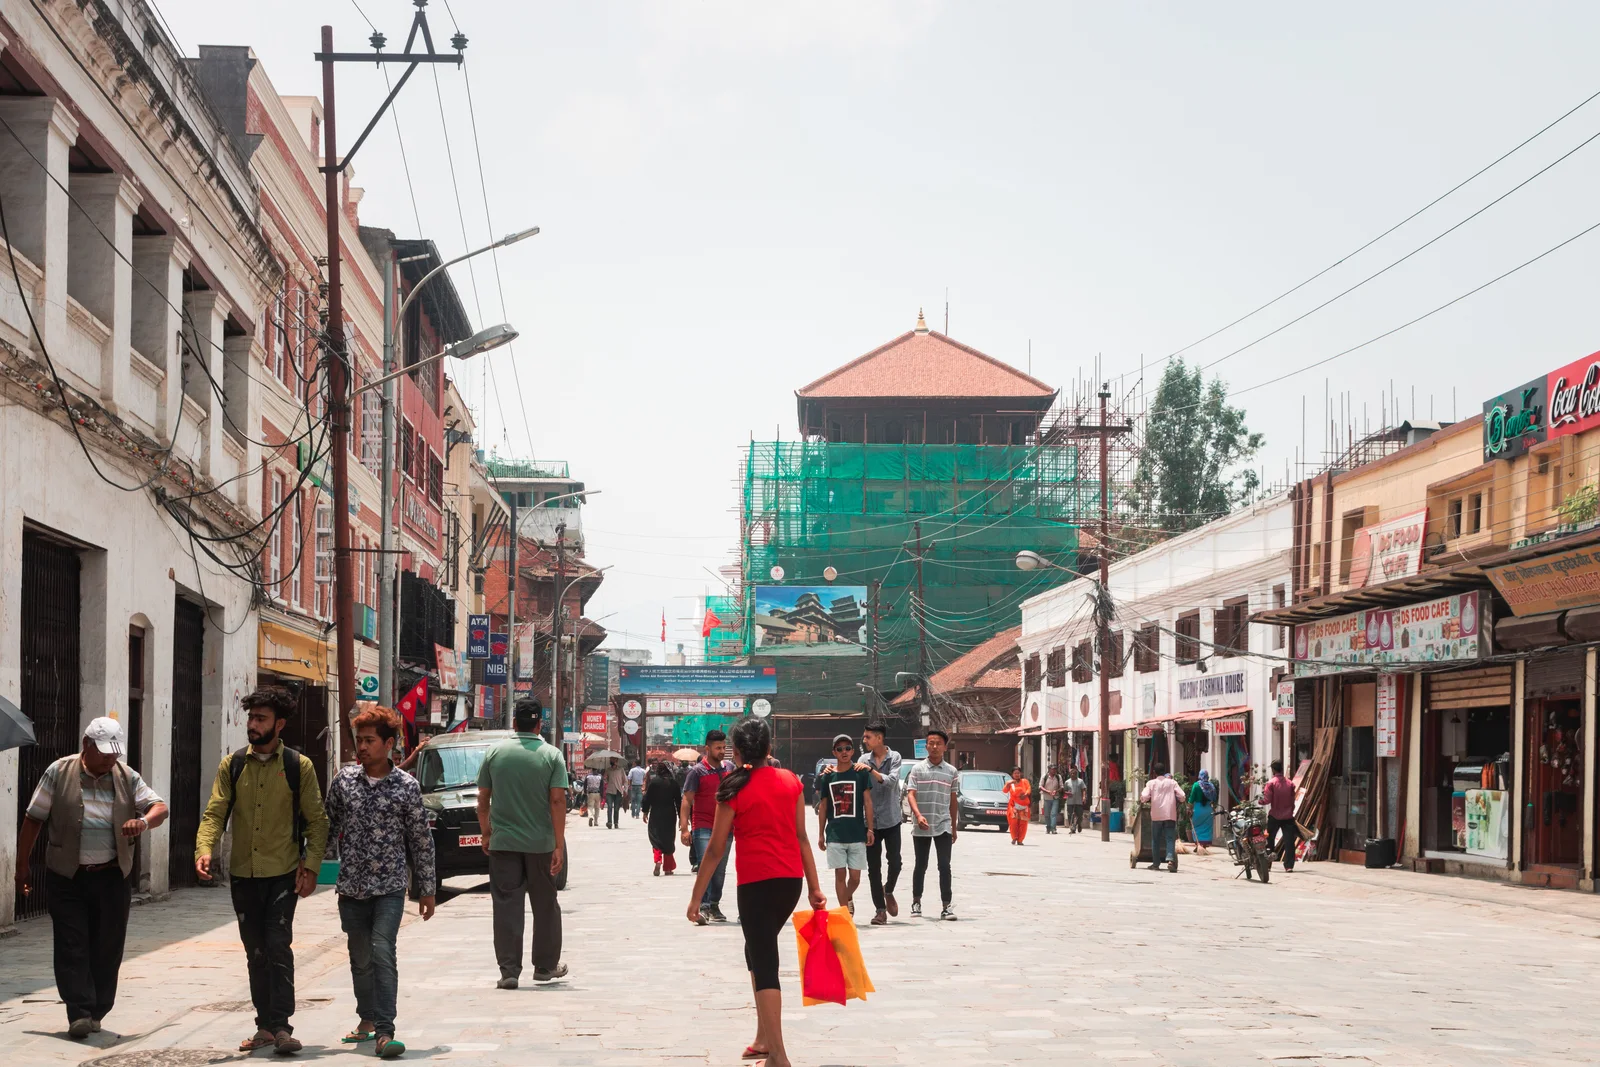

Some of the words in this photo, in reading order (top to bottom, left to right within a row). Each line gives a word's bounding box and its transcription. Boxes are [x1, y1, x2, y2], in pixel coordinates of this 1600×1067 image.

[1549, 361, 1600, 429] Coca-Col
[1392, 524, 1420, 548] FOOD
[470, 617, 488, 626] ATM
[1401, 611, 1410, 625] DS
[1411, 607, 1430, 622] FOOD
[1315, 626, 1324, 638] DS
[1324, 622, 1341, 636] FOOD
[470, 645, 486, 653] NIBL
[1179, 679, 1199, 700] WELCOME
[1199, 676, 1224, 697] PASHMINA
[1225, 673, 1244, 694] HOUSE
[583, 722, 605, 730] CHANGER
[1215, 721, 1245, 733] PASHMINA
